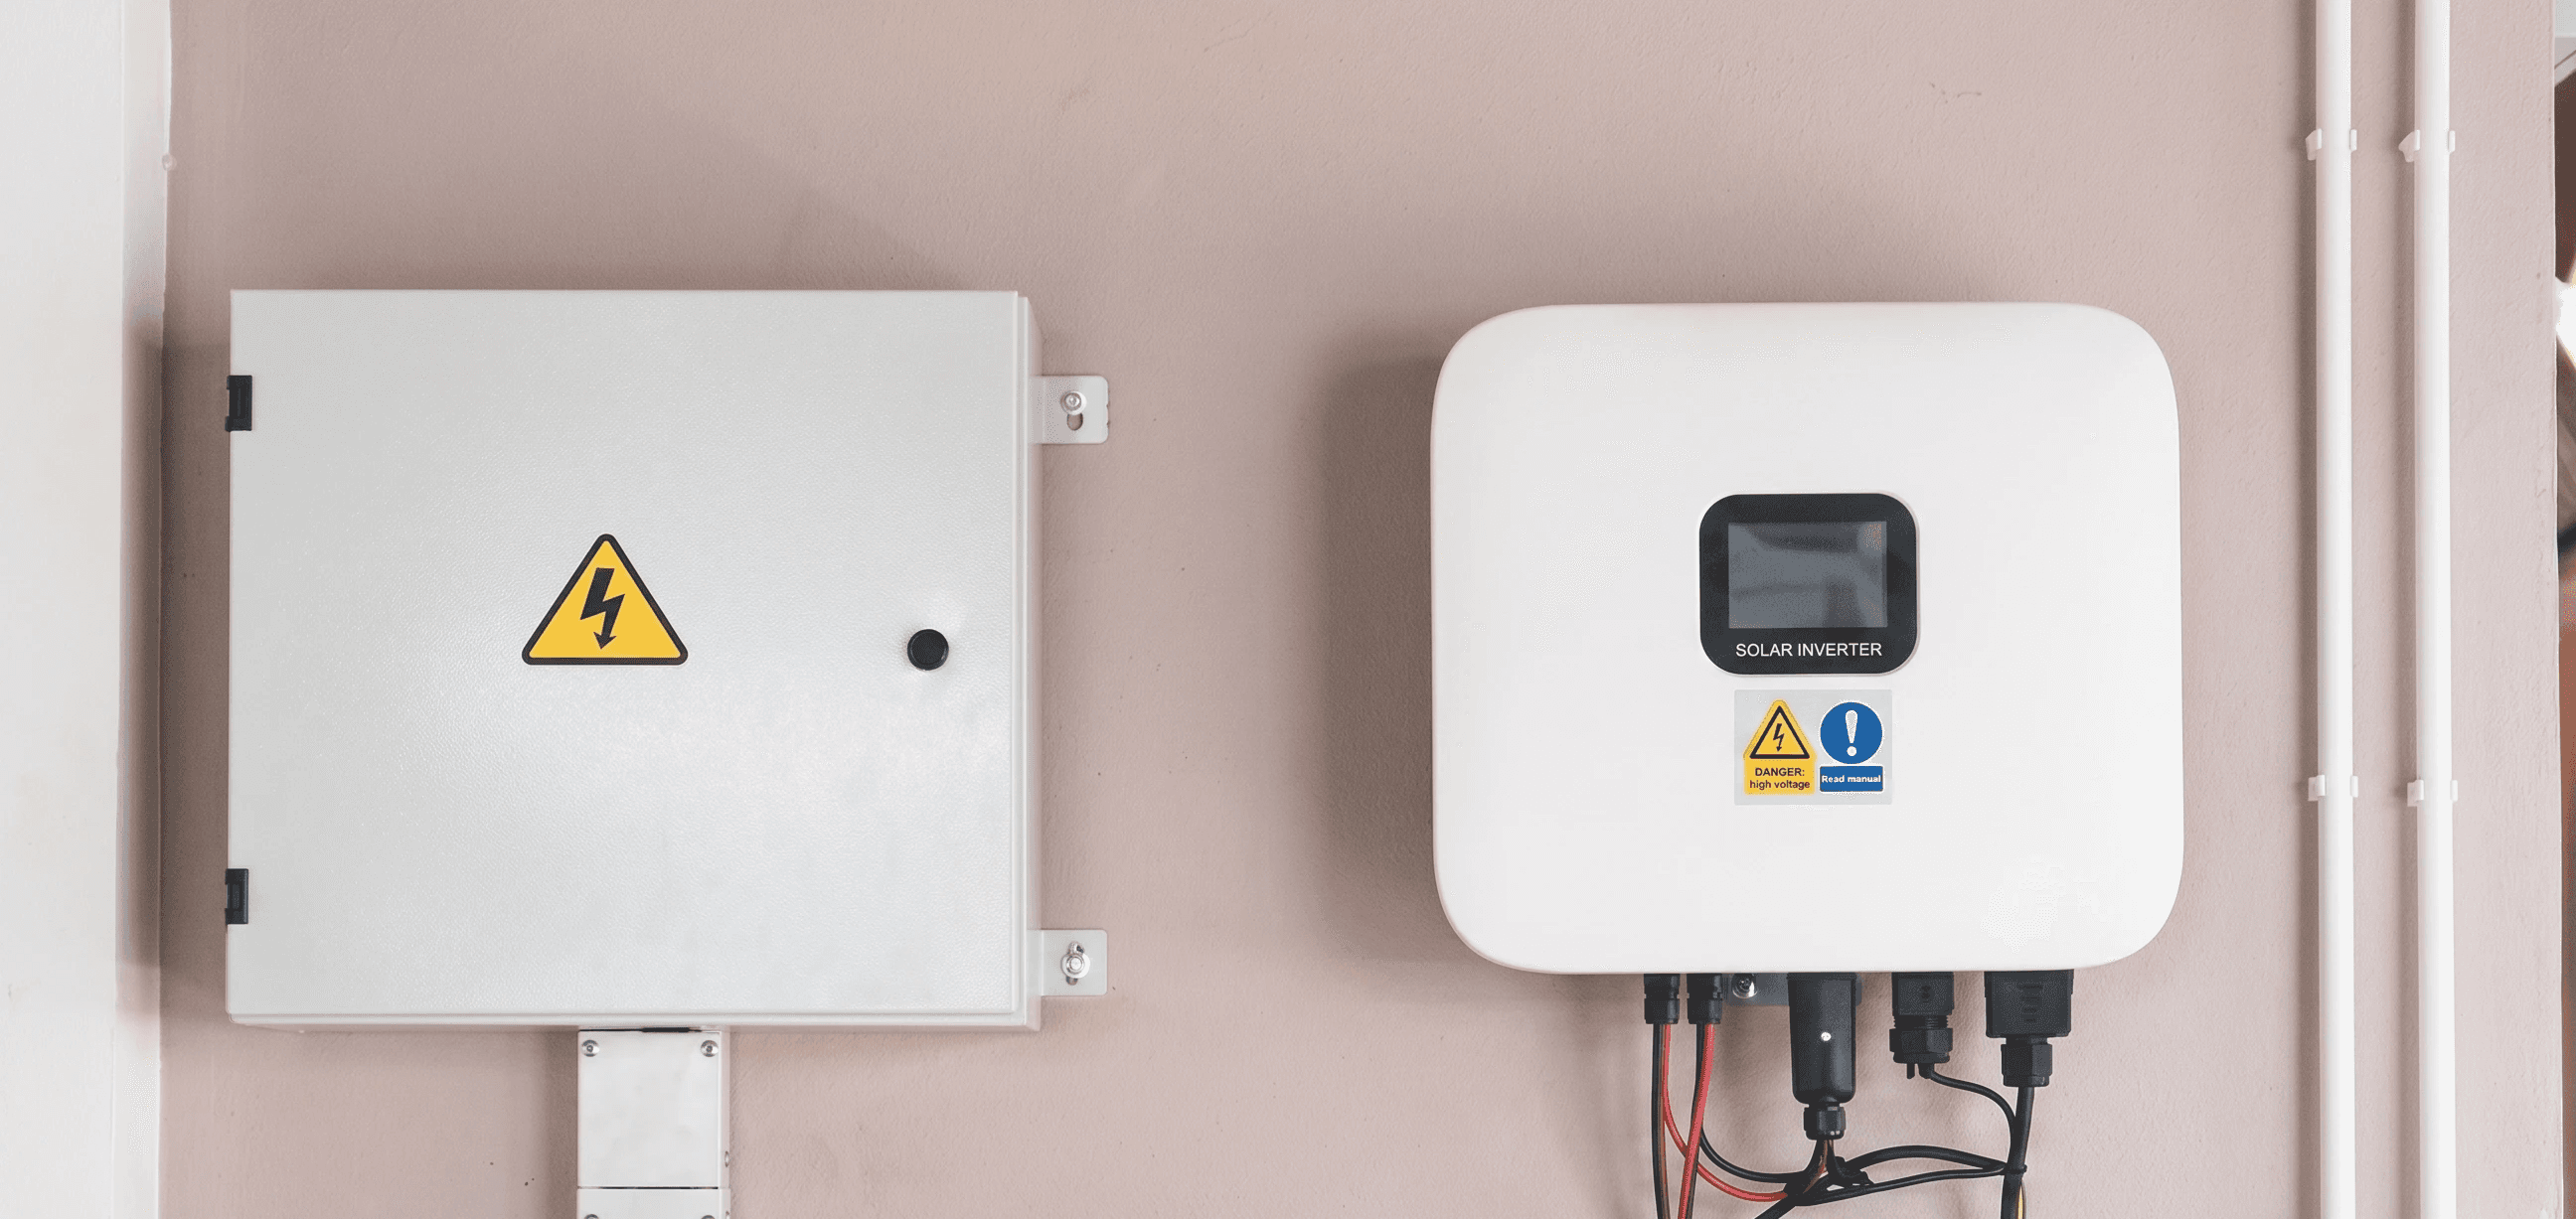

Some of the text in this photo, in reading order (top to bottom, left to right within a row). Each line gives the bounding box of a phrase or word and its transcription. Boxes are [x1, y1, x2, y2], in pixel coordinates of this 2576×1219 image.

[1735, 643, 1883, 657] SOLAR INVERTER
[1754, 767, 1806, 777] DANGER:
[1822, 774, 1881, 783] Read manual
[1749, 779, 1811, 791] high voltage
